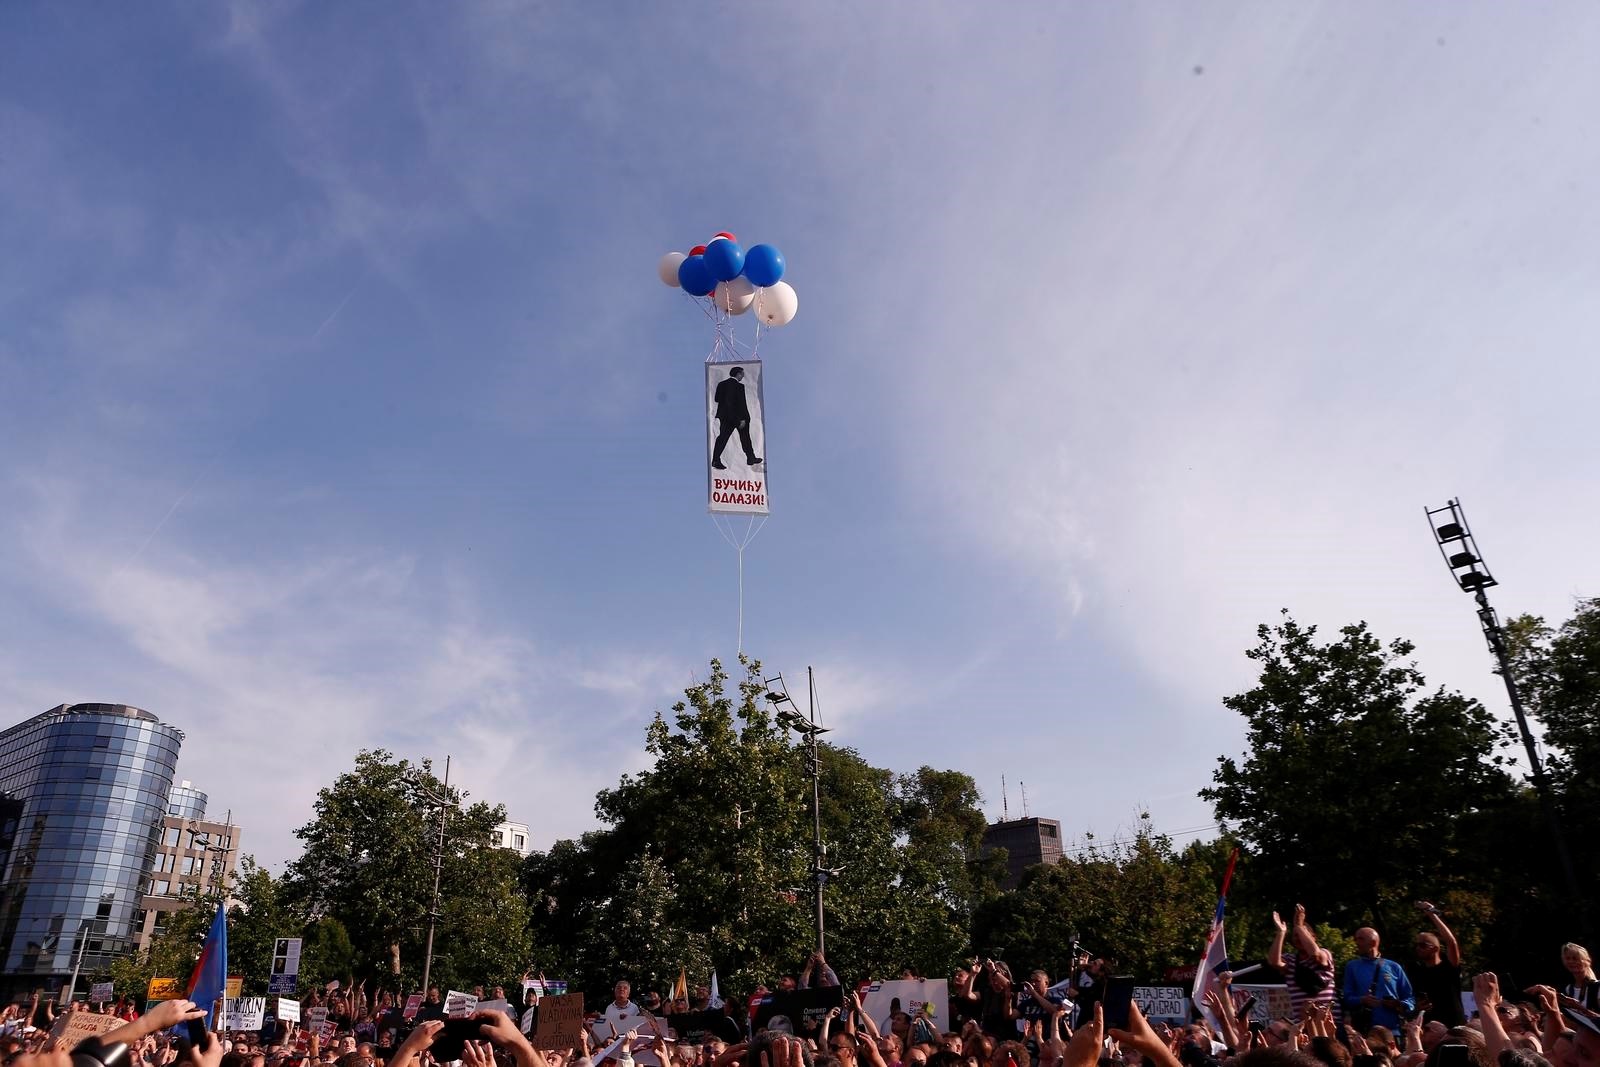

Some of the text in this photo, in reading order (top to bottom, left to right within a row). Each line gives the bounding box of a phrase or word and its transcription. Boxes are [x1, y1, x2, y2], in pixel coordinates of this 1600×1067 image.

[714, 479, 762, 492] ВУЧИЋУ
[713, 491, 765, 505] ОДЛАЗИ!
[1166, 988, 1184, 999] SAD
